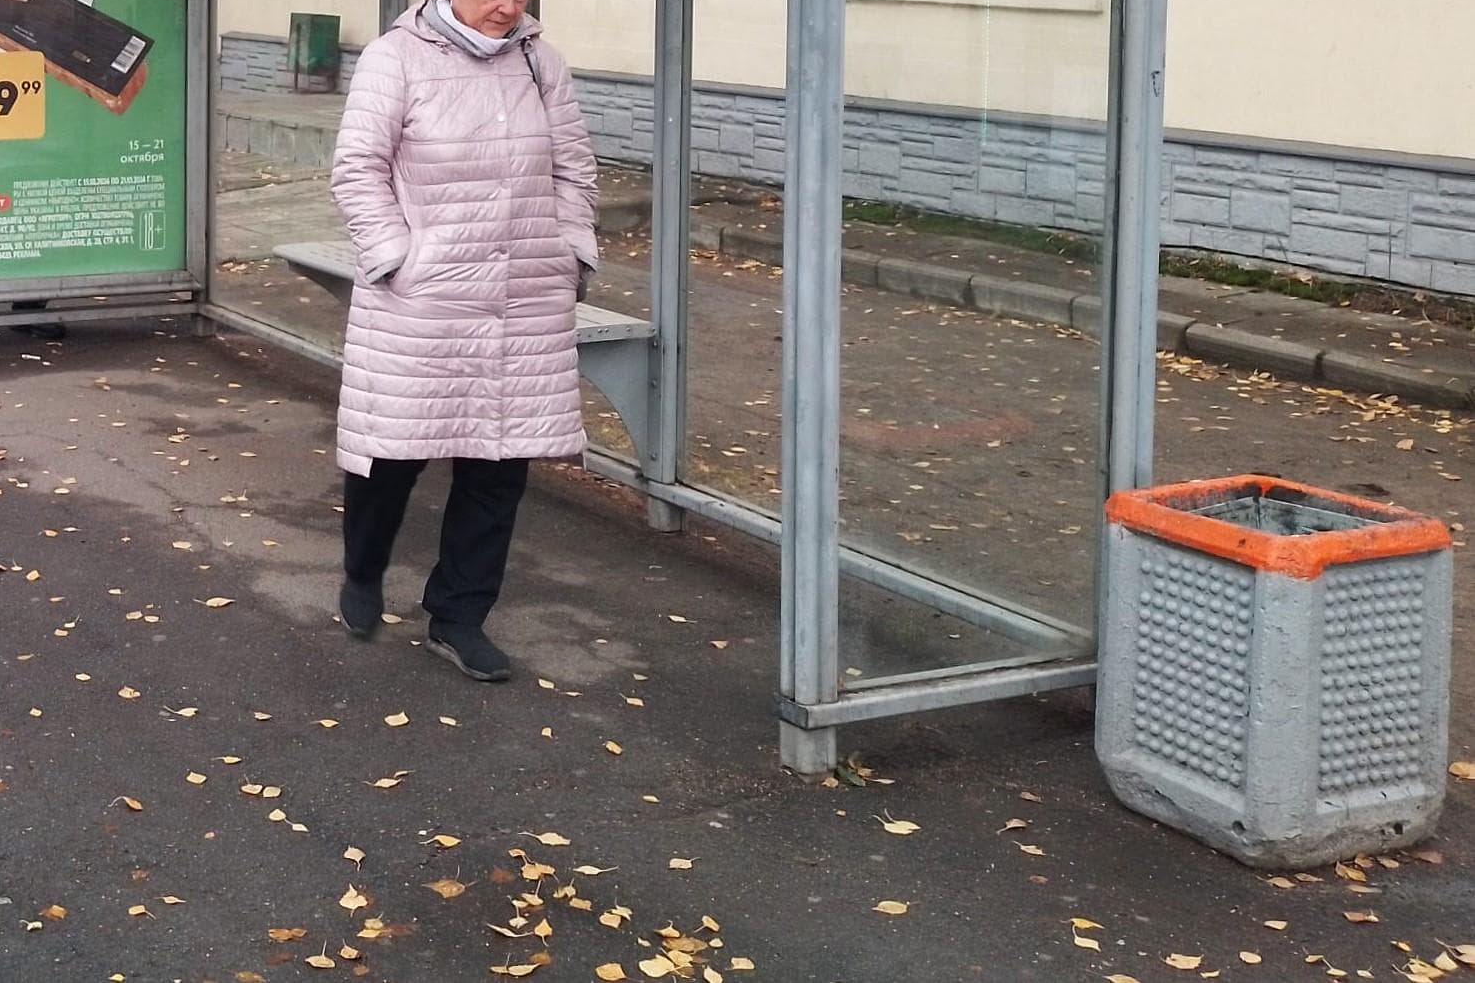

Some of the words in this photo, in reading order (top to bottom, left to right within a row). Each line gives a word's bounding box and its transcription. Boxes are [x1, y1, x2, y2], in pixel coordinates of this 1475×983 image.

[21, 80, 42, 94] 99
[129, 139, 140, 151] 15
[153, 138, 164, 150] 21
[120, 151, 165, 165] октября
